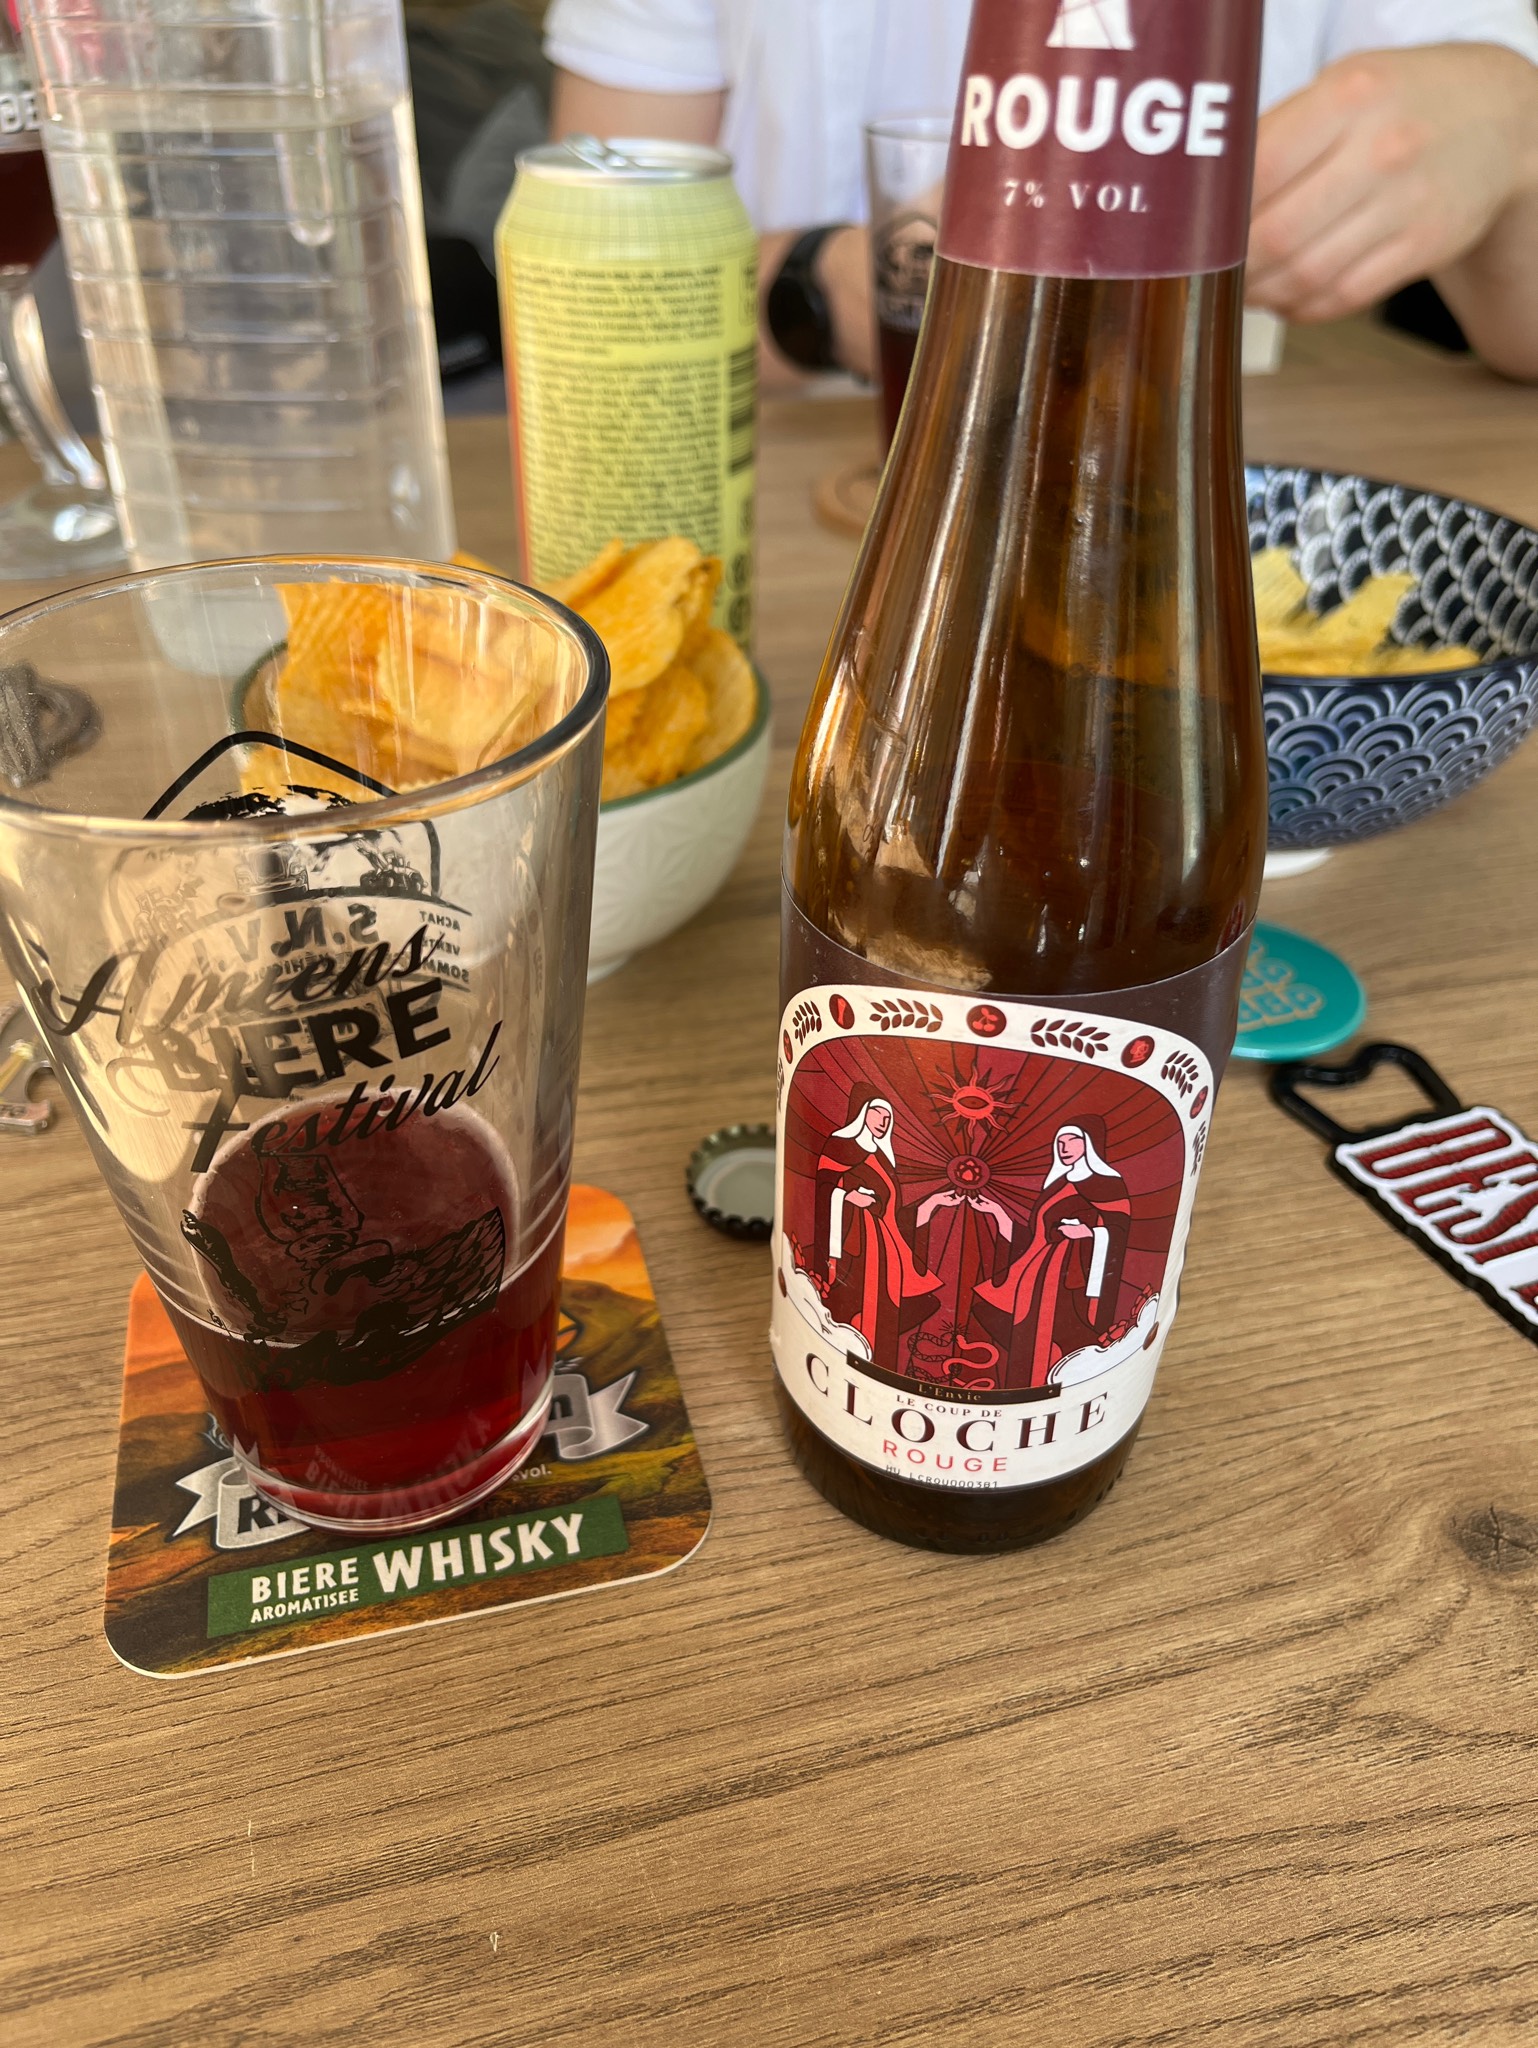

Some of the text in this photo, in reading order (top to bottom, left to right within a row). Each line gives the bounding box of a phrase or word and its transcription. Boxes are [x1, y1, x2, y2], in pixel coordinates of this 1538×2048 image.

[960, 73, 1232, 157] ROUGE
[1003, 179, 1149, 214] 7% VOL
[38, 925, 445, 1048] Amiens
[144, 979, 451, 1099] BIERE
[106, 1021, 503, 1173] Festival
[805, 1352, 1109, 1452] CLOCHE
[896, 1394, 1003, 1418] LE COUP DE
[918, 1384, 981, 1401] L'Envie
[882, 1438, 1008, 1473] ROUGE
[251, 1513, 584, 1604] BIERE WHISKY
[250, 1587, 360, 1624] AROMATISEE
